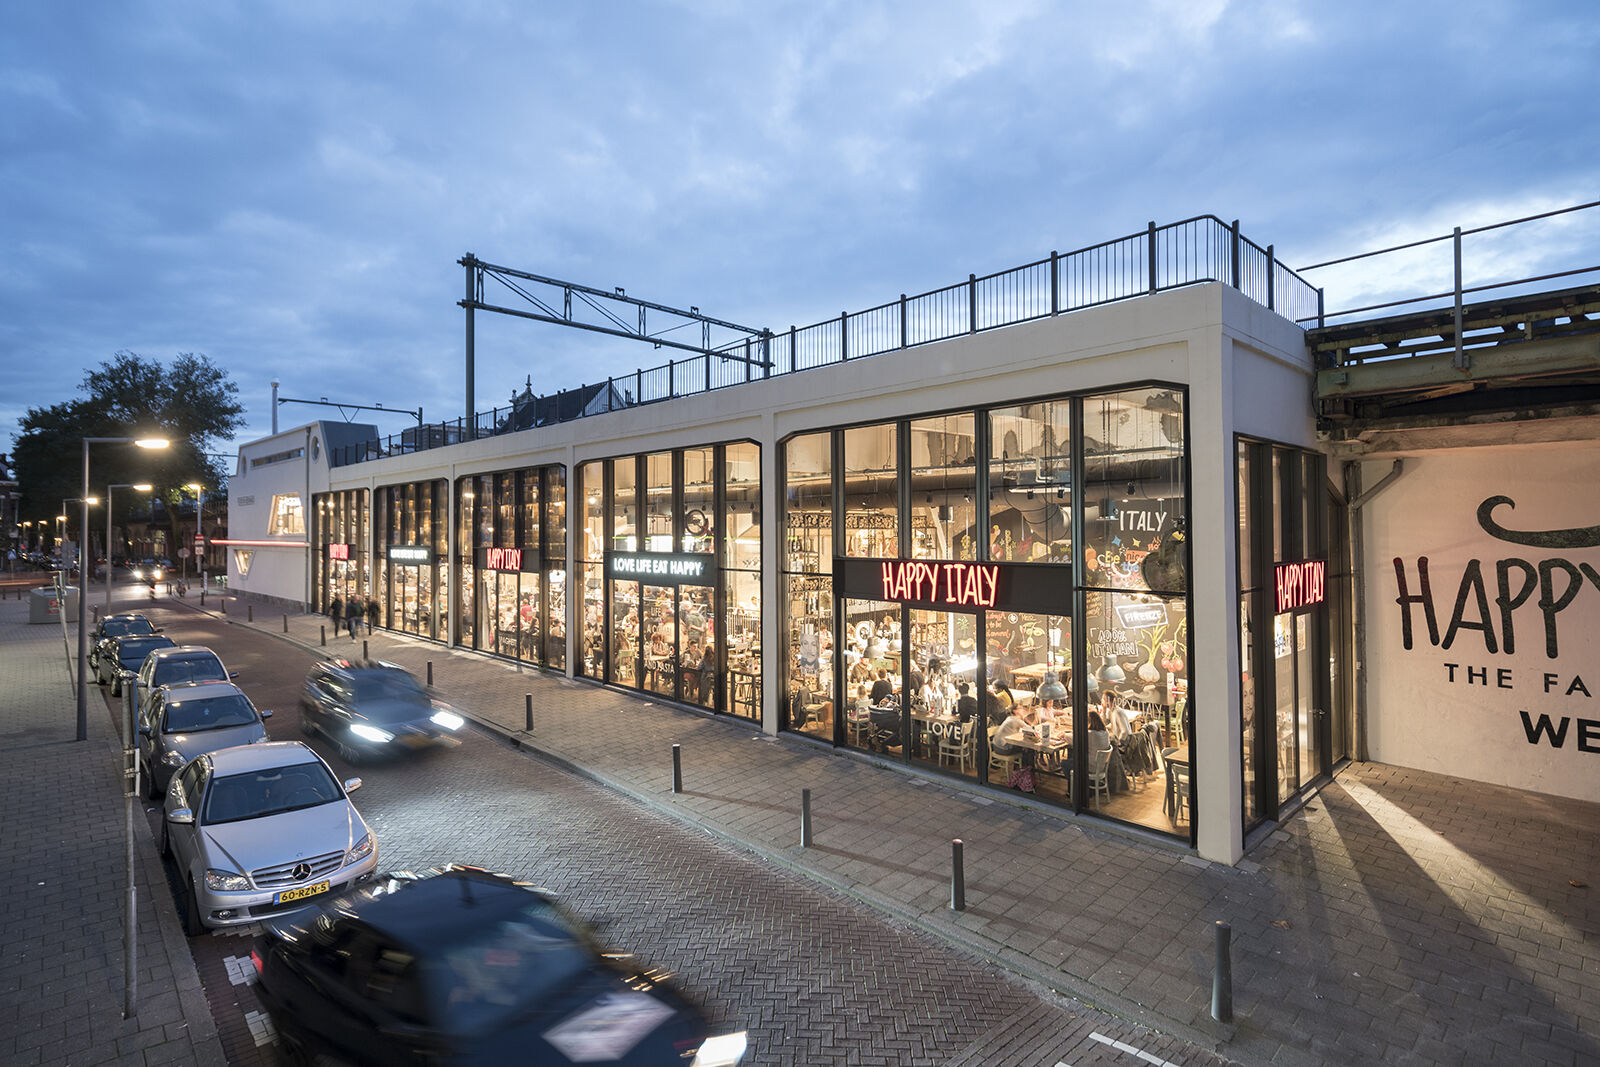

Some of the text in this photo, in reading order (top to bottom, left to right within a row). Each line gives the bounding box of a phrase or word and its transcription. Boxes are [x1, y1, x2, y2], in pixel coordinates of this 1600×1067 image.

[1119, 511, 1168, 532] ITALY
[487, 548, 521, 570] HAPPY ITALY
[613, 558, 702, 576] LOVE LIFE EAT HAPPY
[881, 561, 999, 607] HAPPY ITALY
[1276, 561, 1325, 613] HAPPY ITALY
[1094, 641, 1136, 656] ITALIAN
[1443, 663, 1593, 698] THE FA
[1136, 700, 1163, 719] ITALY
[927, 720, 961, 740] LOVE
[281, 884, 327, 901] 60-RZN-5
